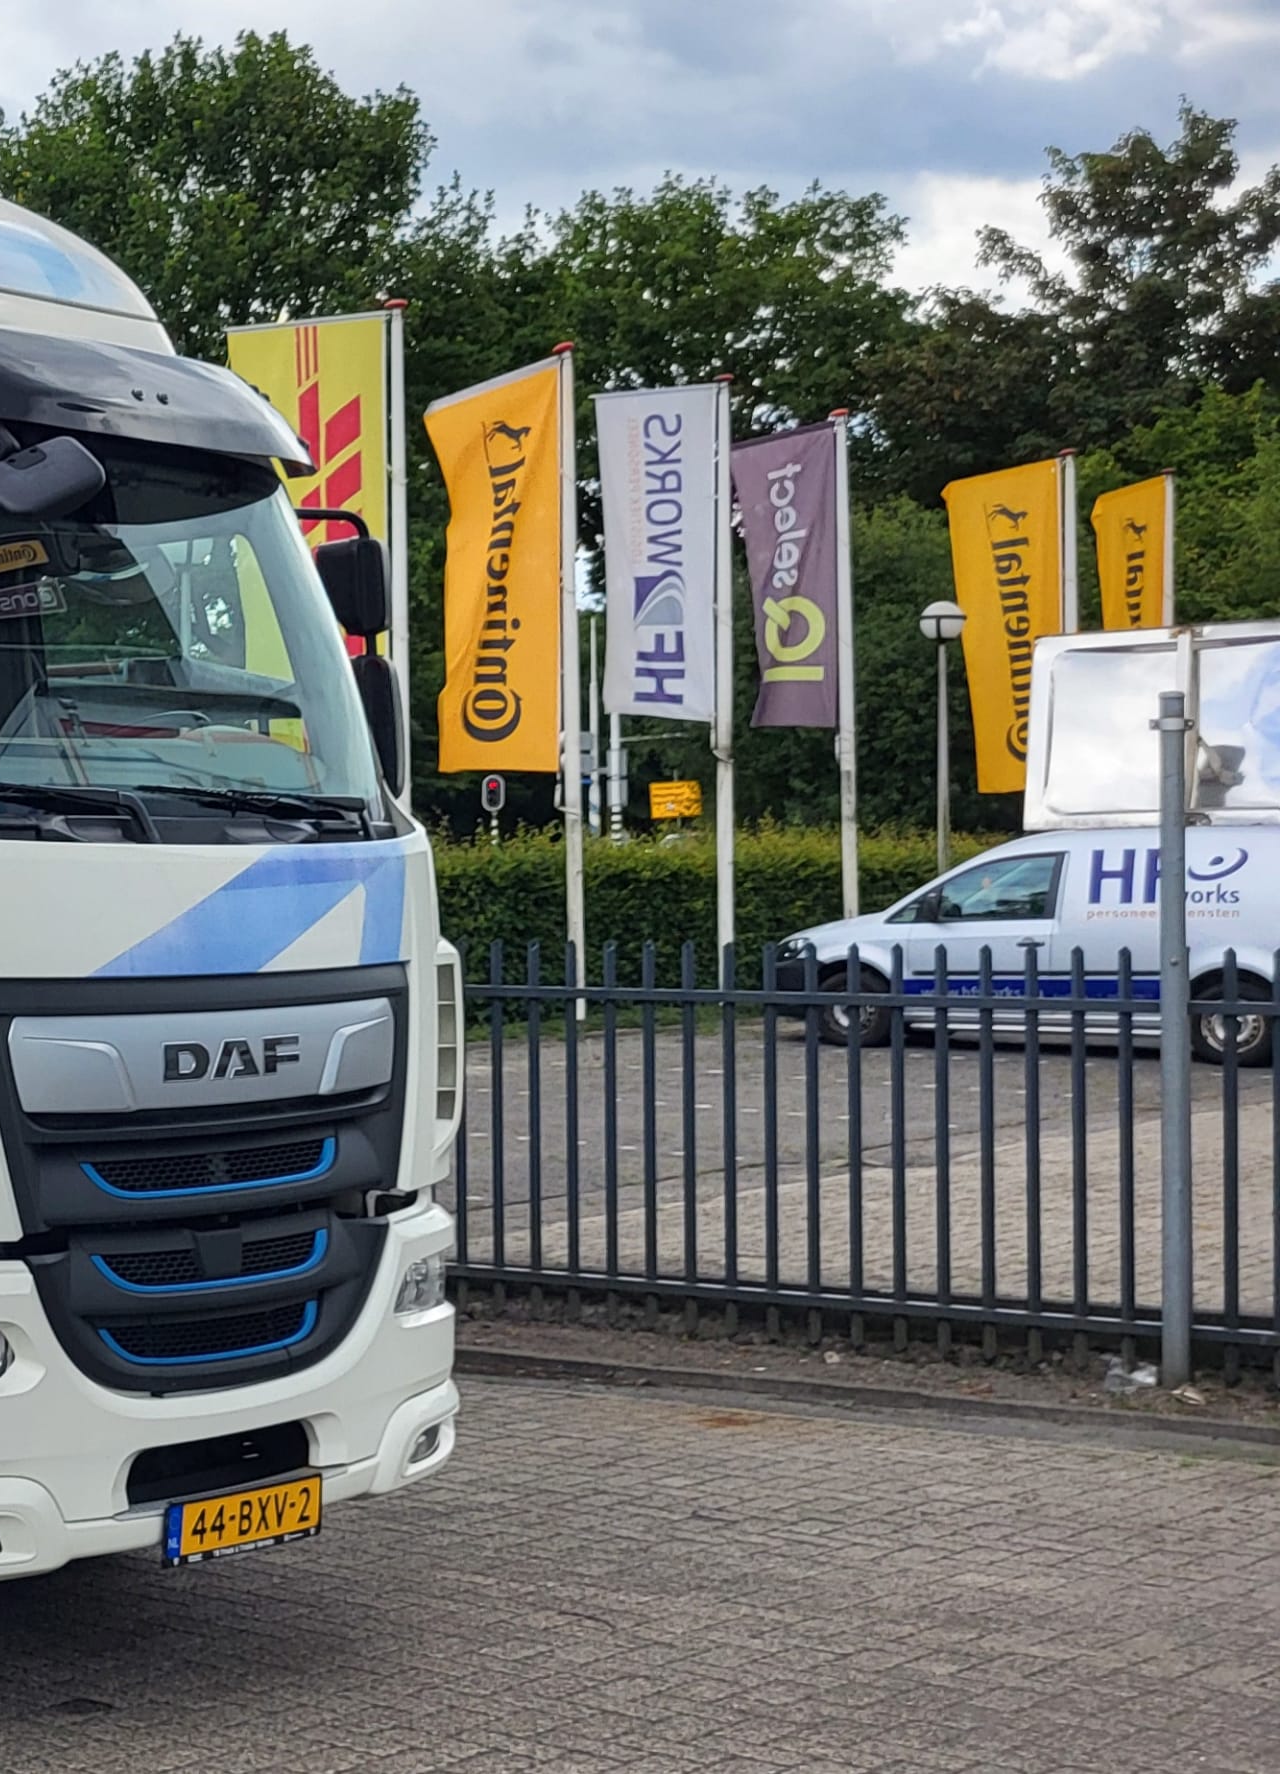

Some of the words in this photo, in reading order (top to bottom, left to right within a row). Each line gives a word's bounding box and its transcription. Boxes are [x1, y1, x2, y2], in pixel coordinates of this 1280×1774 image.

[1184, 883, 1240, 904] orks
[161, 1033, 301, 1083] DAF
[191, 1487, 312, 1546] 44-BXV-2
[167, 1537, 180, 1549] NL
